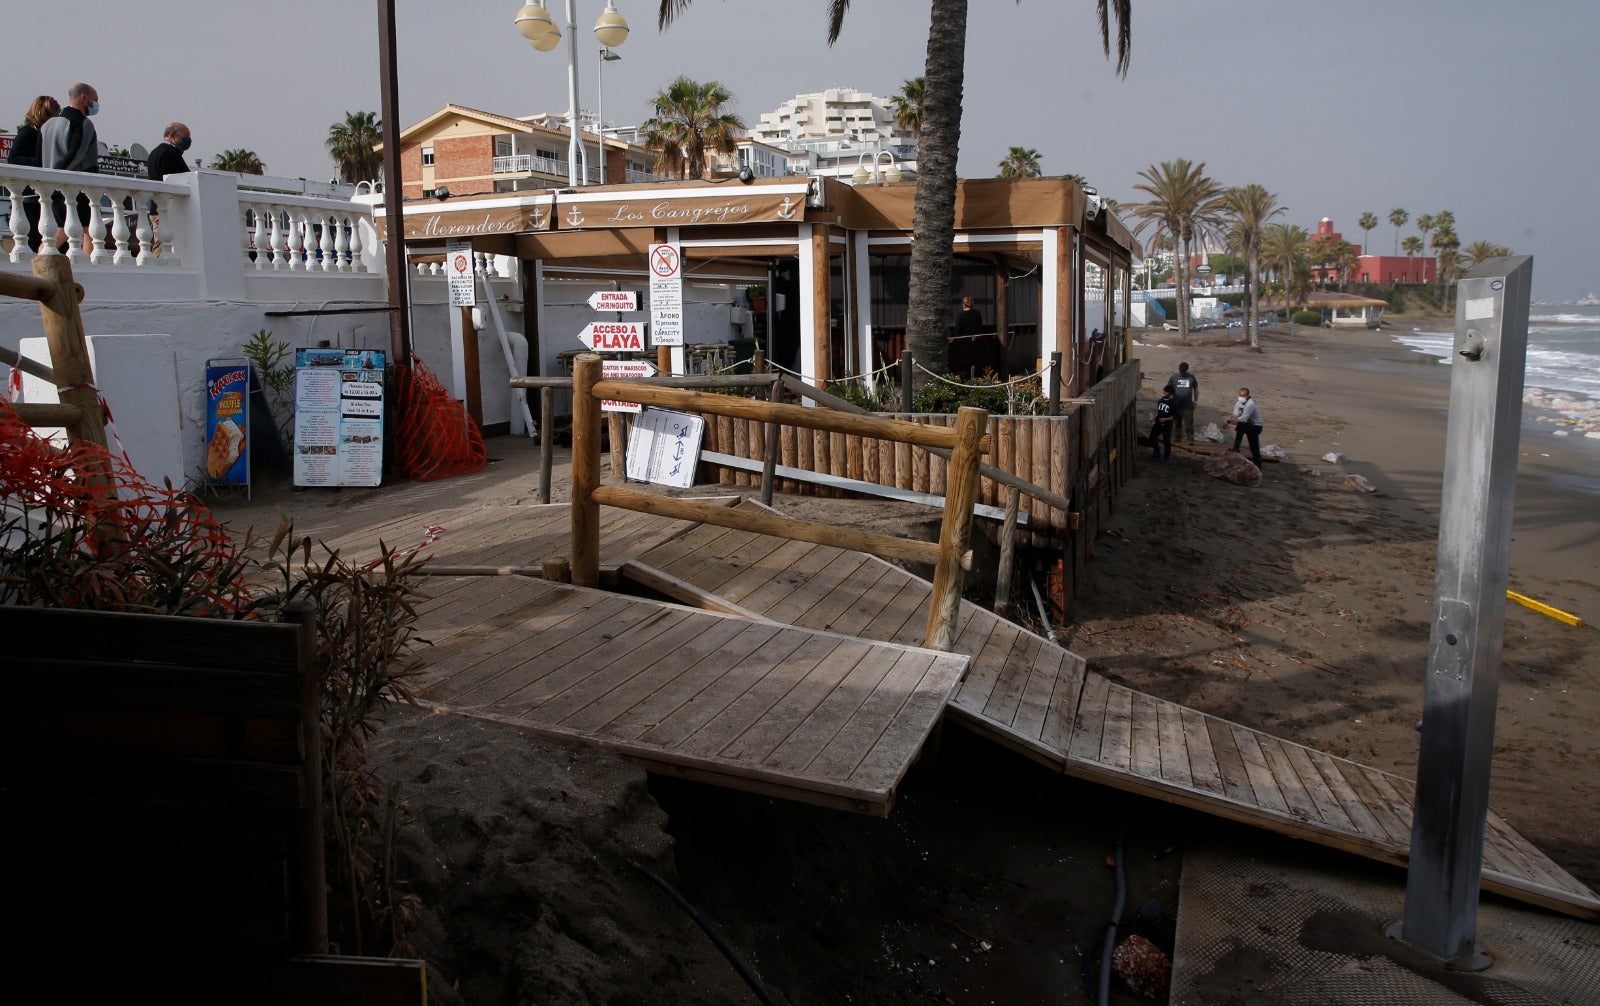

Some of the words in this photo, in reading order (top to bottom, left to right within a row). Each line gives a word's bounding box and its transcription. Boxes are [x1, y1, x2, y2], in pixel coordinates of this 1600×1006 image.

[608, 204, 643, 221] Los
[650, 201, 749, 223] Cangrejos
[412, 214, 515, 236] Merendero
[601, 293, 628, 301] ENTRADA
[593, 326, 628, 334] ACCESO
[630, 326, 637, 334] A
[593, 334, 641, 349] PLAYA
